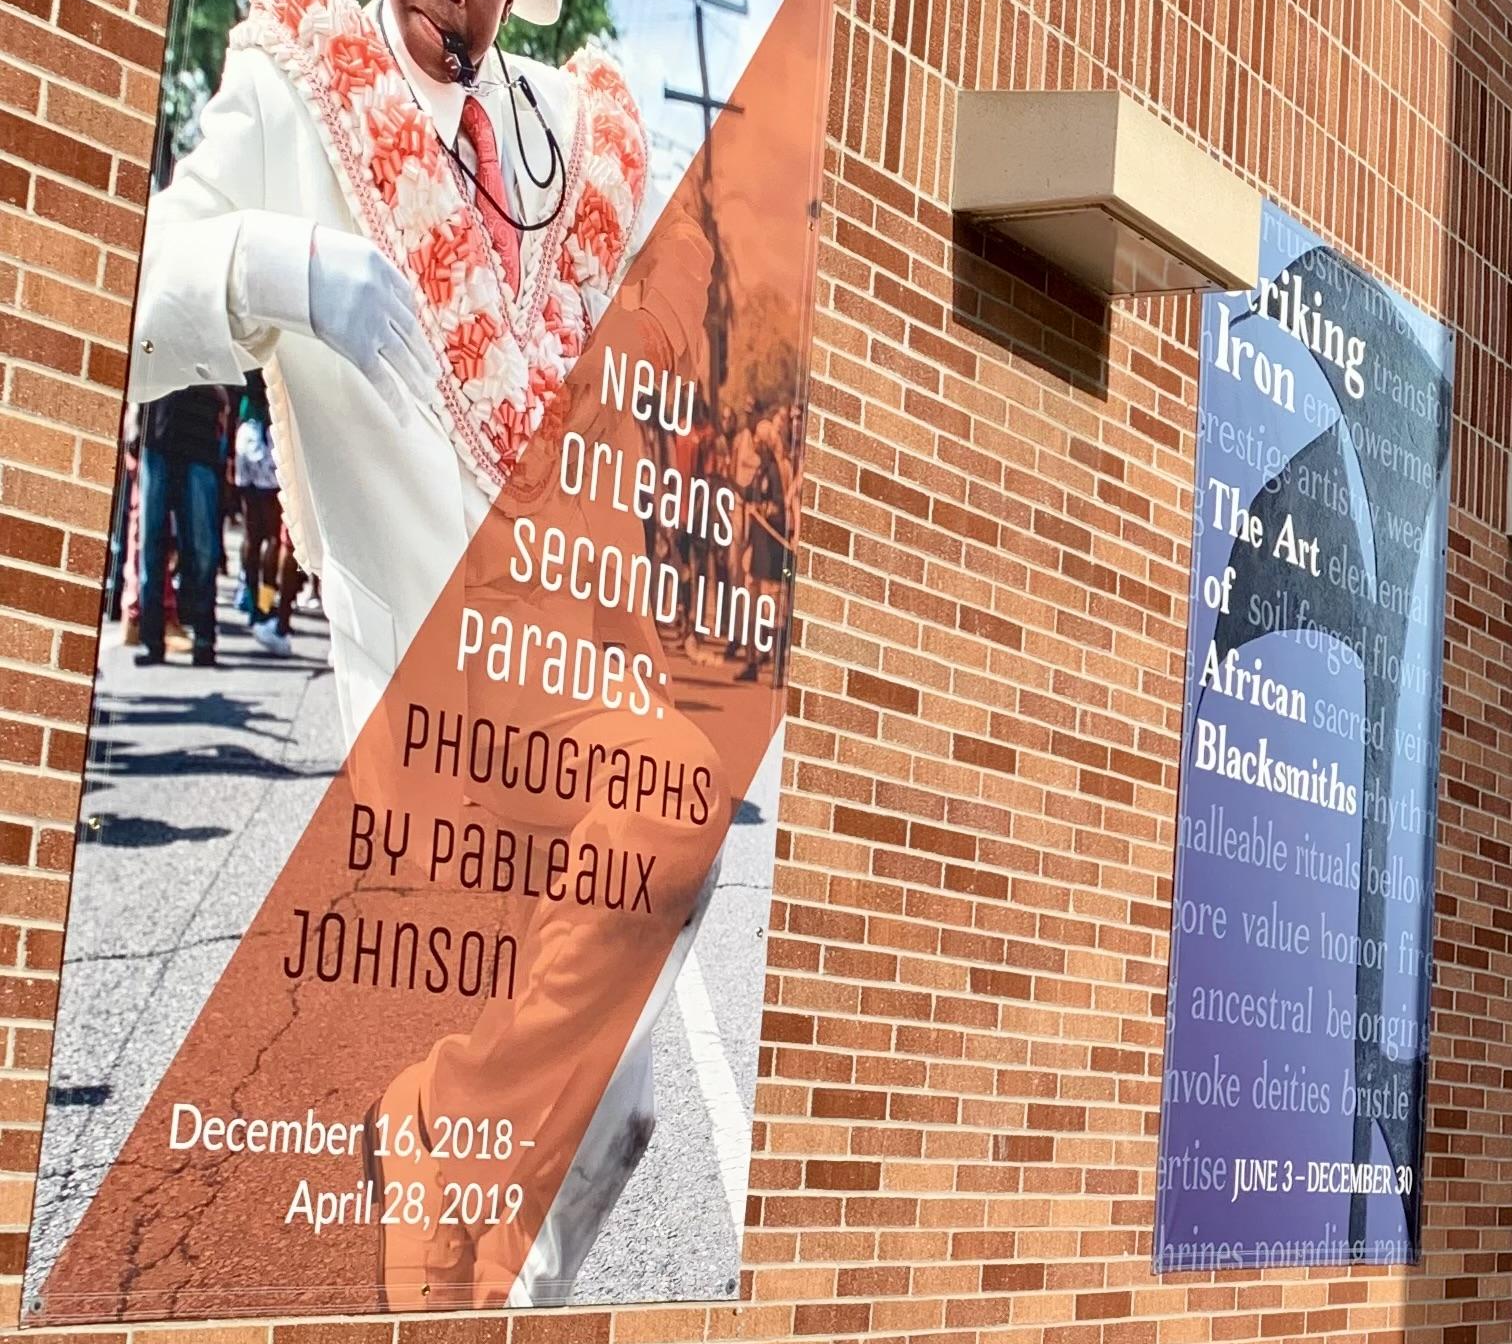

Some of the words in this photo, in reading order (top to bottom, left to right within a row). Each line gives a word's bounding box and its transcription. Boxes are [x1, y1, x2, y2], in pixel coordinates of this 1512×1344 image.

[1214, 302, 1296, 413] Iron
[1225, 269, 1366, 399] riking
[1208, 477, 1264, 548] The
[1273, 513, 1321, 577] Art
[1329, 544, 1428, 626] elemental
[1203, 566, 1236, 615] of
[1249, 590, 1289, 639] soil
[1295, 599, 1367, 675] forged
[1199, 639, 1307, 723] African
[1312, 698, 1385, 752] sacred
[1194, 718, 1357, 816] Blacksmiths
[1294, 832, 1361, 892] rituals
[1241, 900, 1311, 955] value
[1320, 912, 1388, 970] honor
[1191, 984, 1314, 1034] ancestral
[1252, 1057, 1331, 1115] deities
[1341, 1068, 1410, 1120] bristle
[169, 1102, 364, 1156] December
[373, 1113, 422, 1164] 16,
[284, 1179, 374, 1234] April
[380, 1181, 430, 1231] 28,
[438, 1182, 524, 1226] 2019
[1231, 1158, 1278, 1203] JUNE
[1306, 1160, 1393, 1194] DECEMBER
[1394, 1164, 1414, 1196] 30
